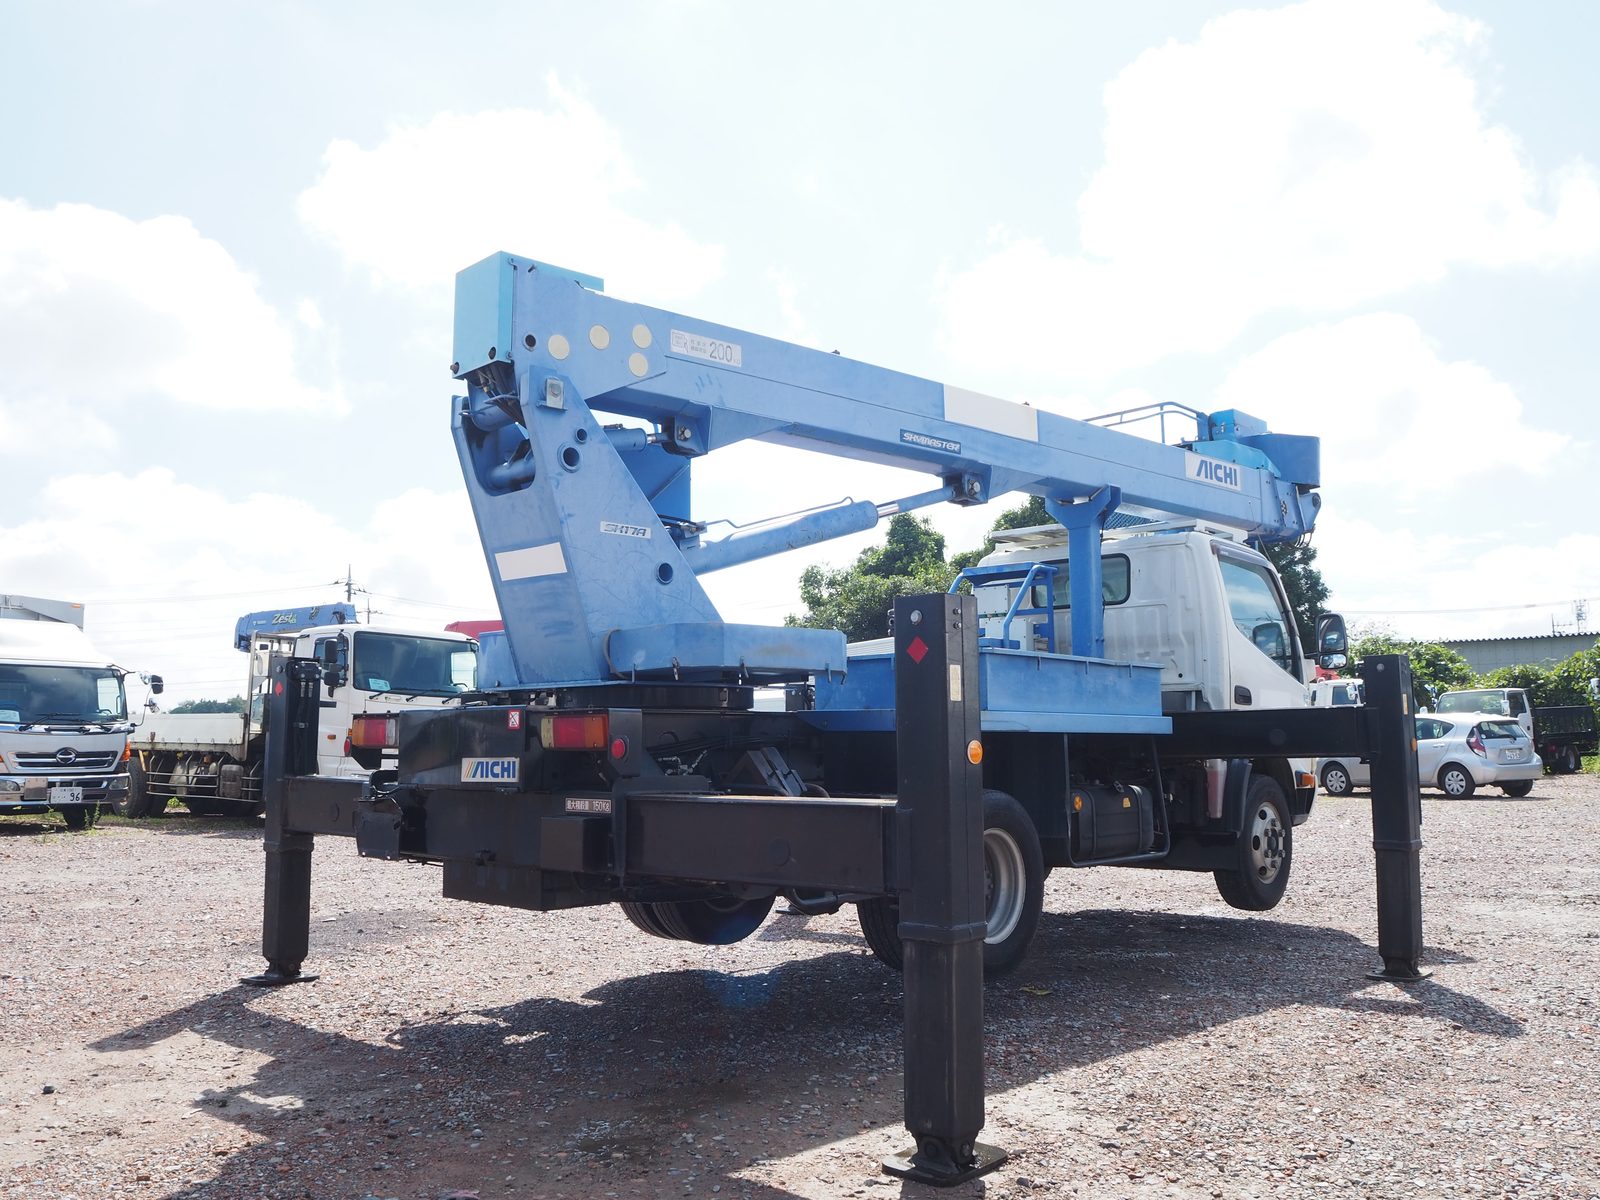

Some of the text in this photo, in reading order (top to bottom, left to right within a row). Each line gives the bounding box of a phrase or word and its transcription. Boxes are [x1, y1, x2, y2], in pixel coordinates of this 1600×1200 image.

[903, 432, 960, 451] SKYMASTER
[1196, 459, 1238, 486] AICHI
[471, 760, 516, 779] AICHI
